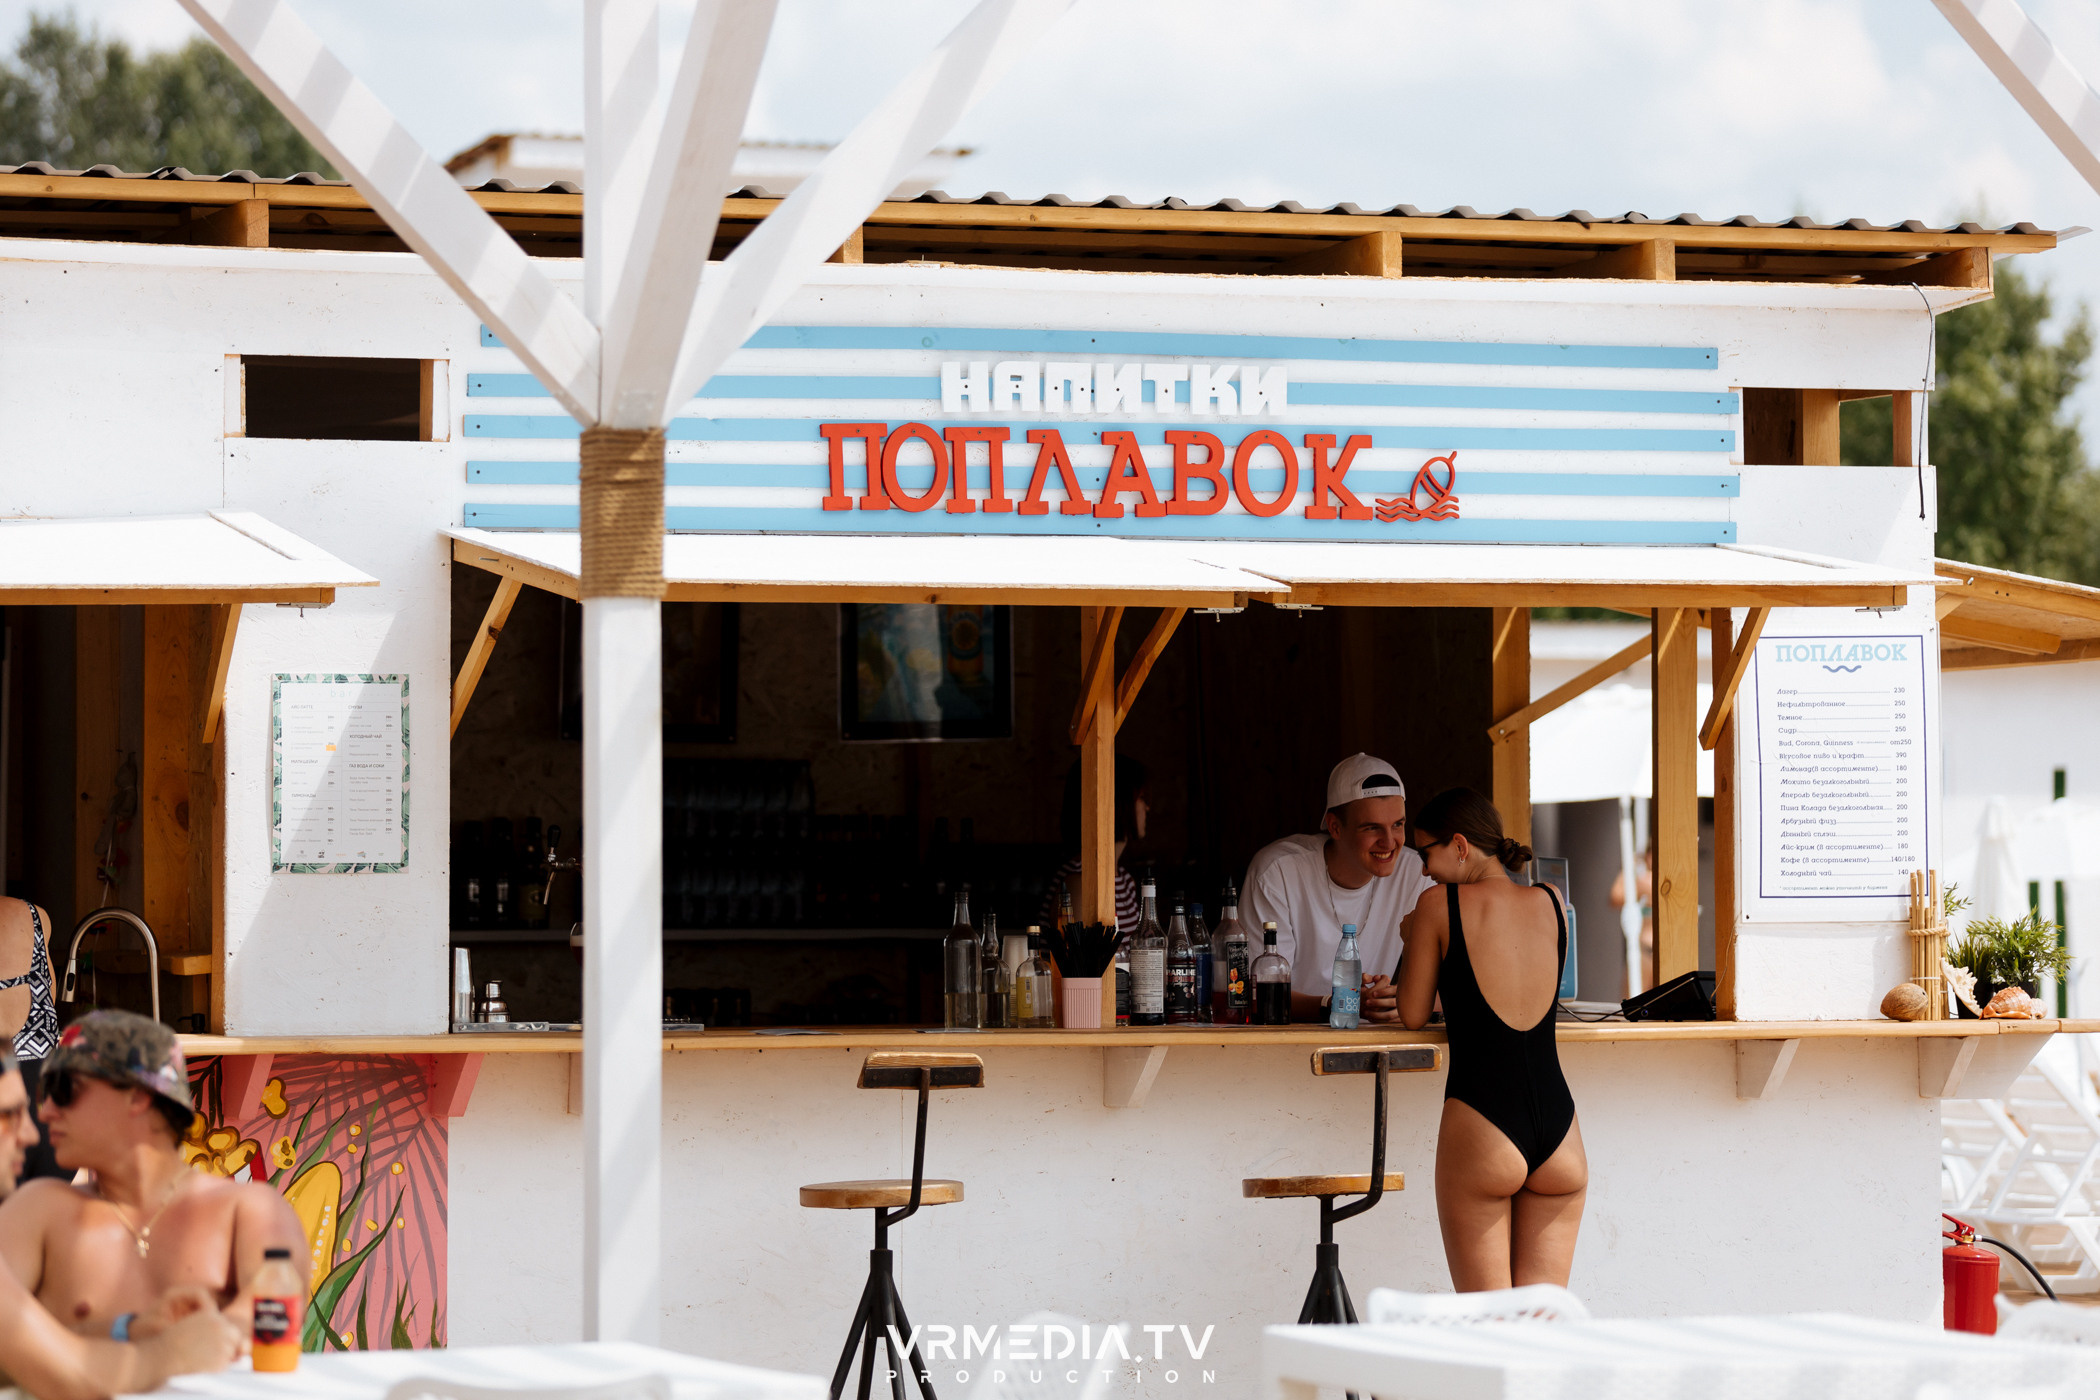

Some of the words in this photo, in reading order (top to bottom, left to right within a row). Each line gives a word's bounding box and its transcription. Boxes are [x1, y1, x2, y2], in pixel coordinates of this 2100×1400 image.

[941, 361, 1288, 415] НАПИТКИ
[820, 422, 1373, 520] ПОПЛАВОК
[1775, 643, 1907, 663] ПОПЛАВОК
[1812, 778, 1869, 786] безалкогольный
